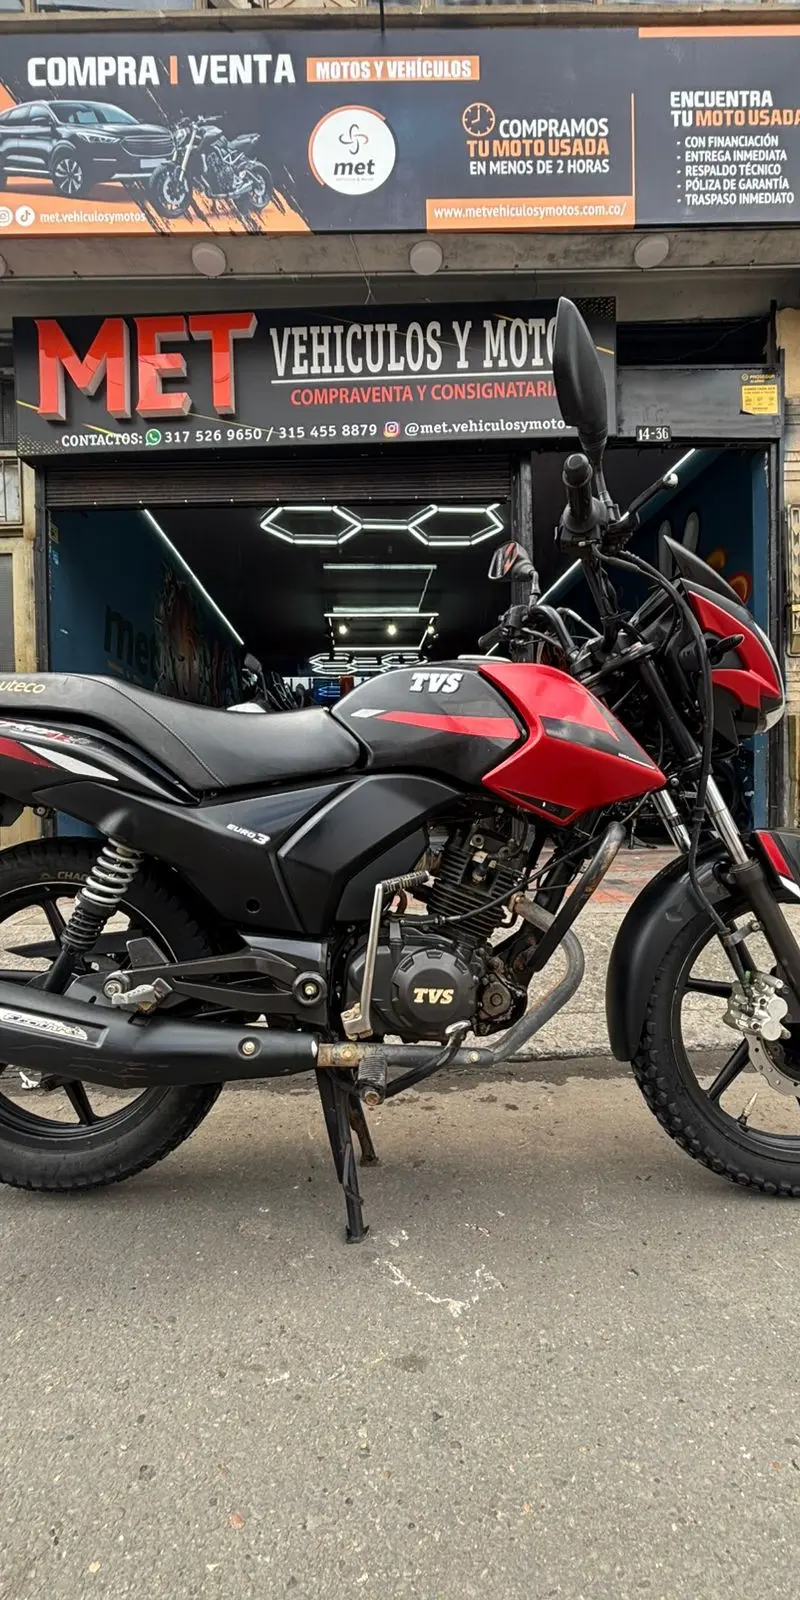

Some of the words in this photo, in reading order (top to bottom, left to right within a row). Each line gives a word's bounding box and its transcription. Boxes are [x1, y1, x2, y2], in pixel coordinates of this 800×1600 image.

[27, 56, 161, 87] COMPRA
[187, 54, 296, 84] VENTA
[316, 61, 371, 80] MOTOS
[374, 60, 384, 79] Y
[387, 57, 472, 79] VEHÍCULOS
[670, 90, 774, 108] ENCUENTRA
[670, 110, 693, 127] TU
[696, 109, 746, 126] MOTO
[499, 118, 609, 138] COMPRAMOS
[466, 140, 490, 158] TU
[493, 139, 546, 157] MOTO
[549, 138, 610, 156] USADA
[685, 136, 706, 148] CON
[708, 133, 779, 148] FINANCIACIÓN
[685, 151, 731, 162] ENTREGA
[733, 150, 788, 161] INMEDIATA
[334, 159, 376, 176] met
[470, 161, 487, 175] EN
[490, 160, 534, 175] MENOS
[537, 160, 553, 174] DE
[556, 159, 564, 174] 2
[568, 159, 610, 174] HORAS
[685, 164, 737, 176] RESPALDO
[739, 161, 782, 176] TÉCNICO
[685, 177, 721, 191] PÓLIZA
[723, 179, 736, 190] DE
[738, 176, 790, 190] GARANTÍA
[685, 193, 737, 205] TRASPASO
[739, 192, 795, 205] INMEDIATO
[40, 210, 146, 225] met.vehiculosymotos
[433, 202, 627, 220] www.metvehiculosymotos.com.co/
[270, 320, 442, 376] VEHICULOS
[452, 320, 473, 369] Y
[34, 312, 258, 421] MET
[290, 384, 413, 406] COMPRAVENTA
[416, 385, 428, 400] Y
[431, 381, 557, 401] CONSIGNATARI
[61, 432, 143, 447] CONTACTOS:
[164, 431, 190, 443] 317
[195, 430, 222, 442] 526
[226, 428, 262, 441] 9650
[279, 426, 305, 439] 315
[310, 425, 337, 437] 455
[342, 424, 378, 436] 8879
[404, 419, 573, 436] @met.vehiculosymoto
[638, 427, 670, 440] 14-36
[409, 673, 464, 694] TVS
[226, 823, 257, 839] EURO
[252, 832, 271, 845] 3
[413, 987, 455, 1005] TVS
